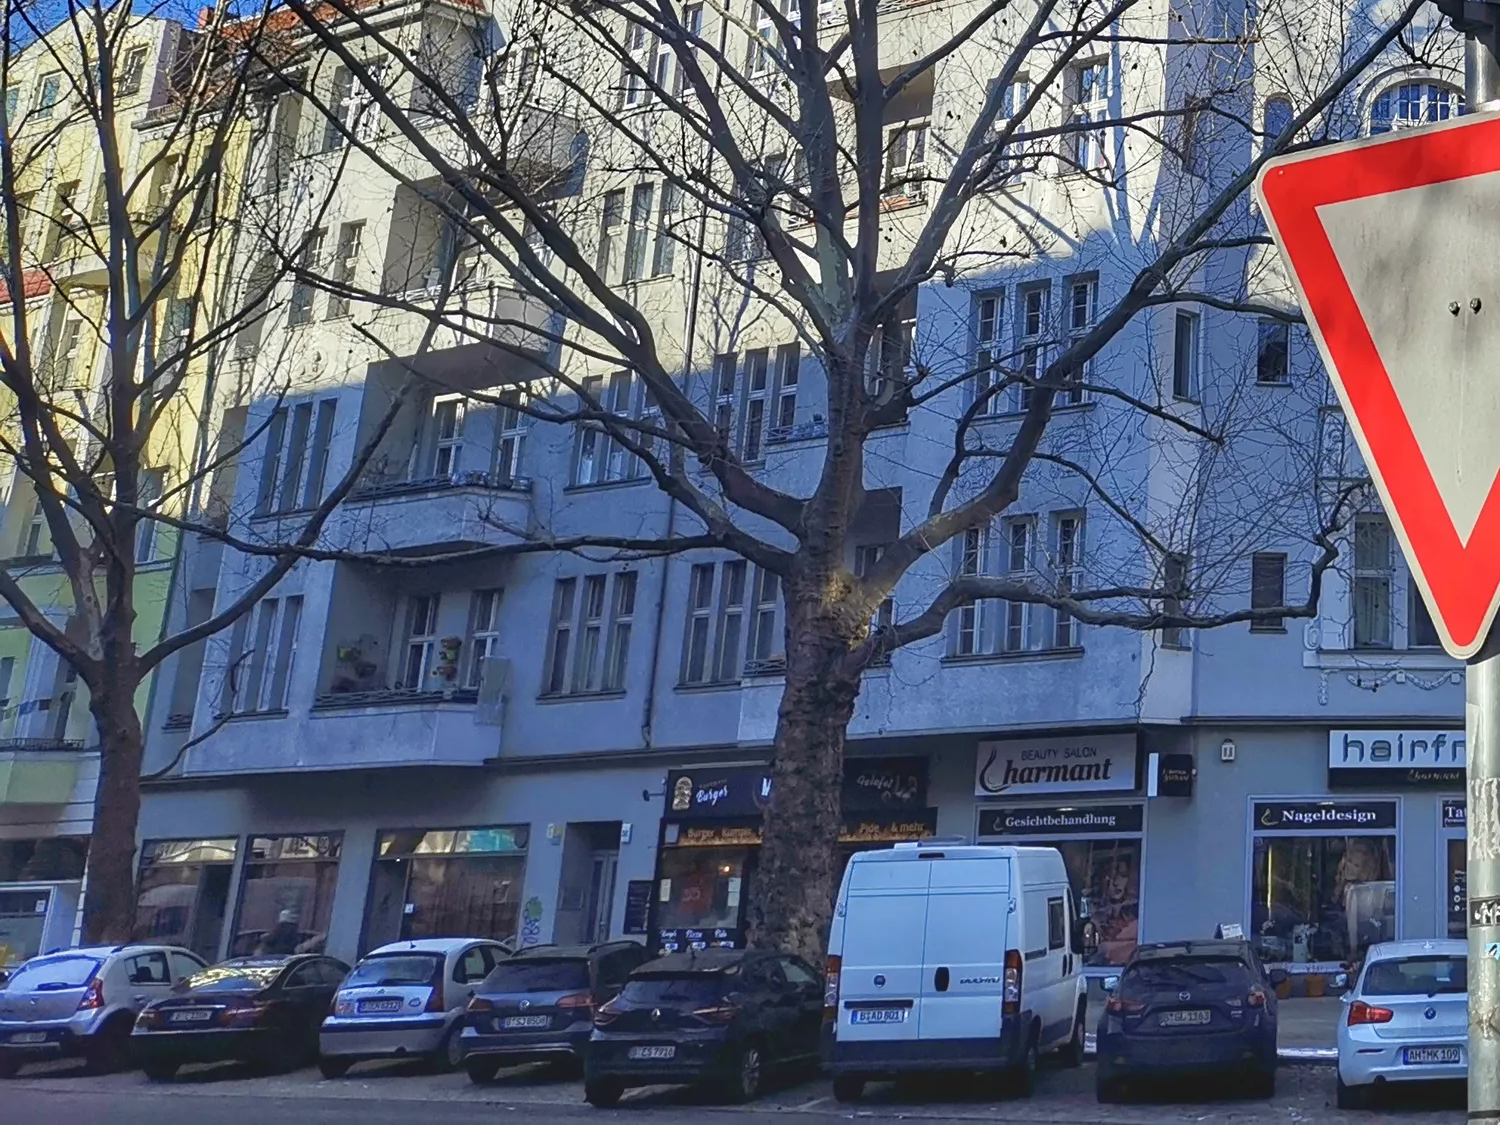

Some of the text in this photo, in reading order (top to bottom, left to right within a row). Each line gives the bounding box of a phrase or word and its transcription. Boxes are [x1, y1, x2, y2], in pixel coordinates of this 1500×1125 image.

[1021, 747, 1097, 761] BEAUTY SALON
[1342, 733, 1466, 763] hairfr
[1005, 813, 1116, 828] Gesichtbehandlung
[1282, 808, 1377, 823] Nageldesign
